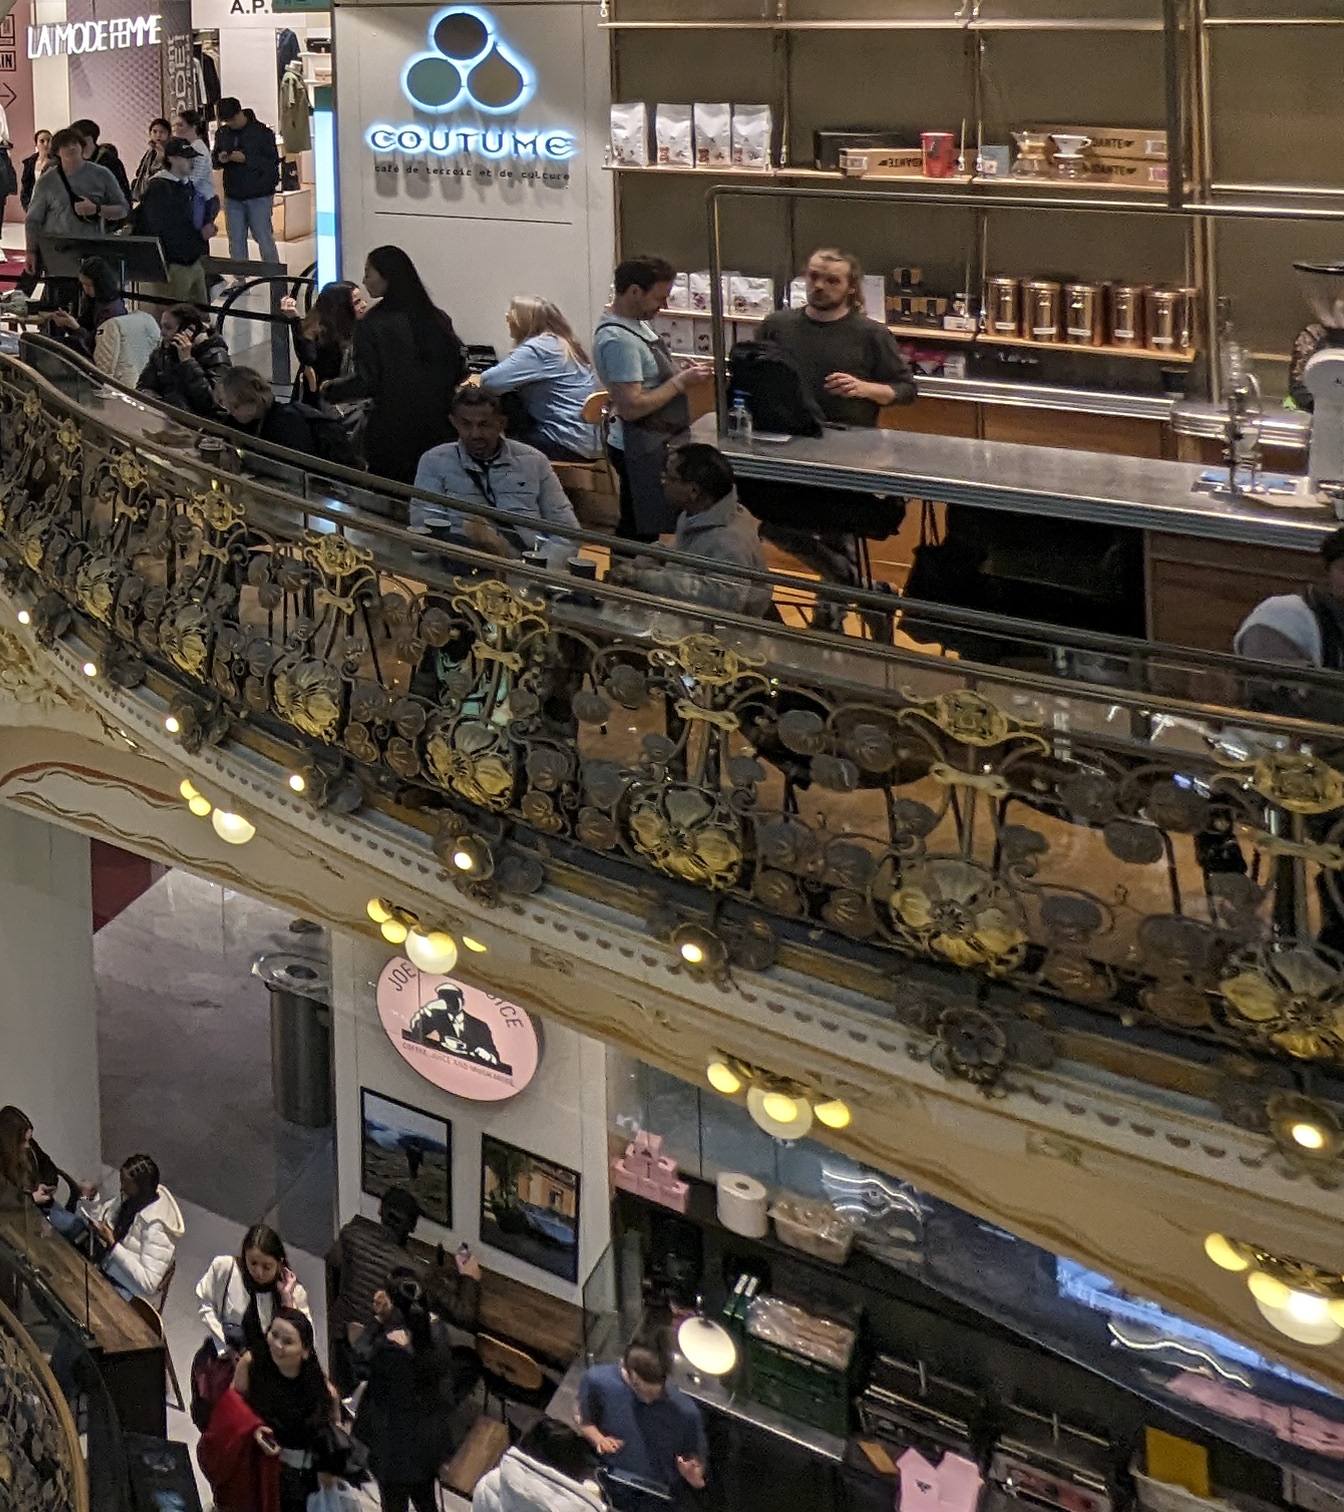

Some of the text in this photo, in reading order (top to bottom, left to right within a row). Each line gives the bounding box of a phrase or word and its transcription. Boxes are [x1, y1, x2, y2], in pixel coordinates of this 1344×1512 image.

[27, 25, 52, 60] LA
[55, 20, 109, 56] MODE
[109, 14, 162, 50] FEMME
[370, 129, 574, 157] COUTUME
[374, 163, 399, 174] café
[406, 165, 419, 175] de
[479, 169, 493, 178] et
[499, 170, 513, 179] de
[521, 170, 570, 182] culture
[388, 962, 417, 992] JOE
[486, 993, 523, 1029] ICE
